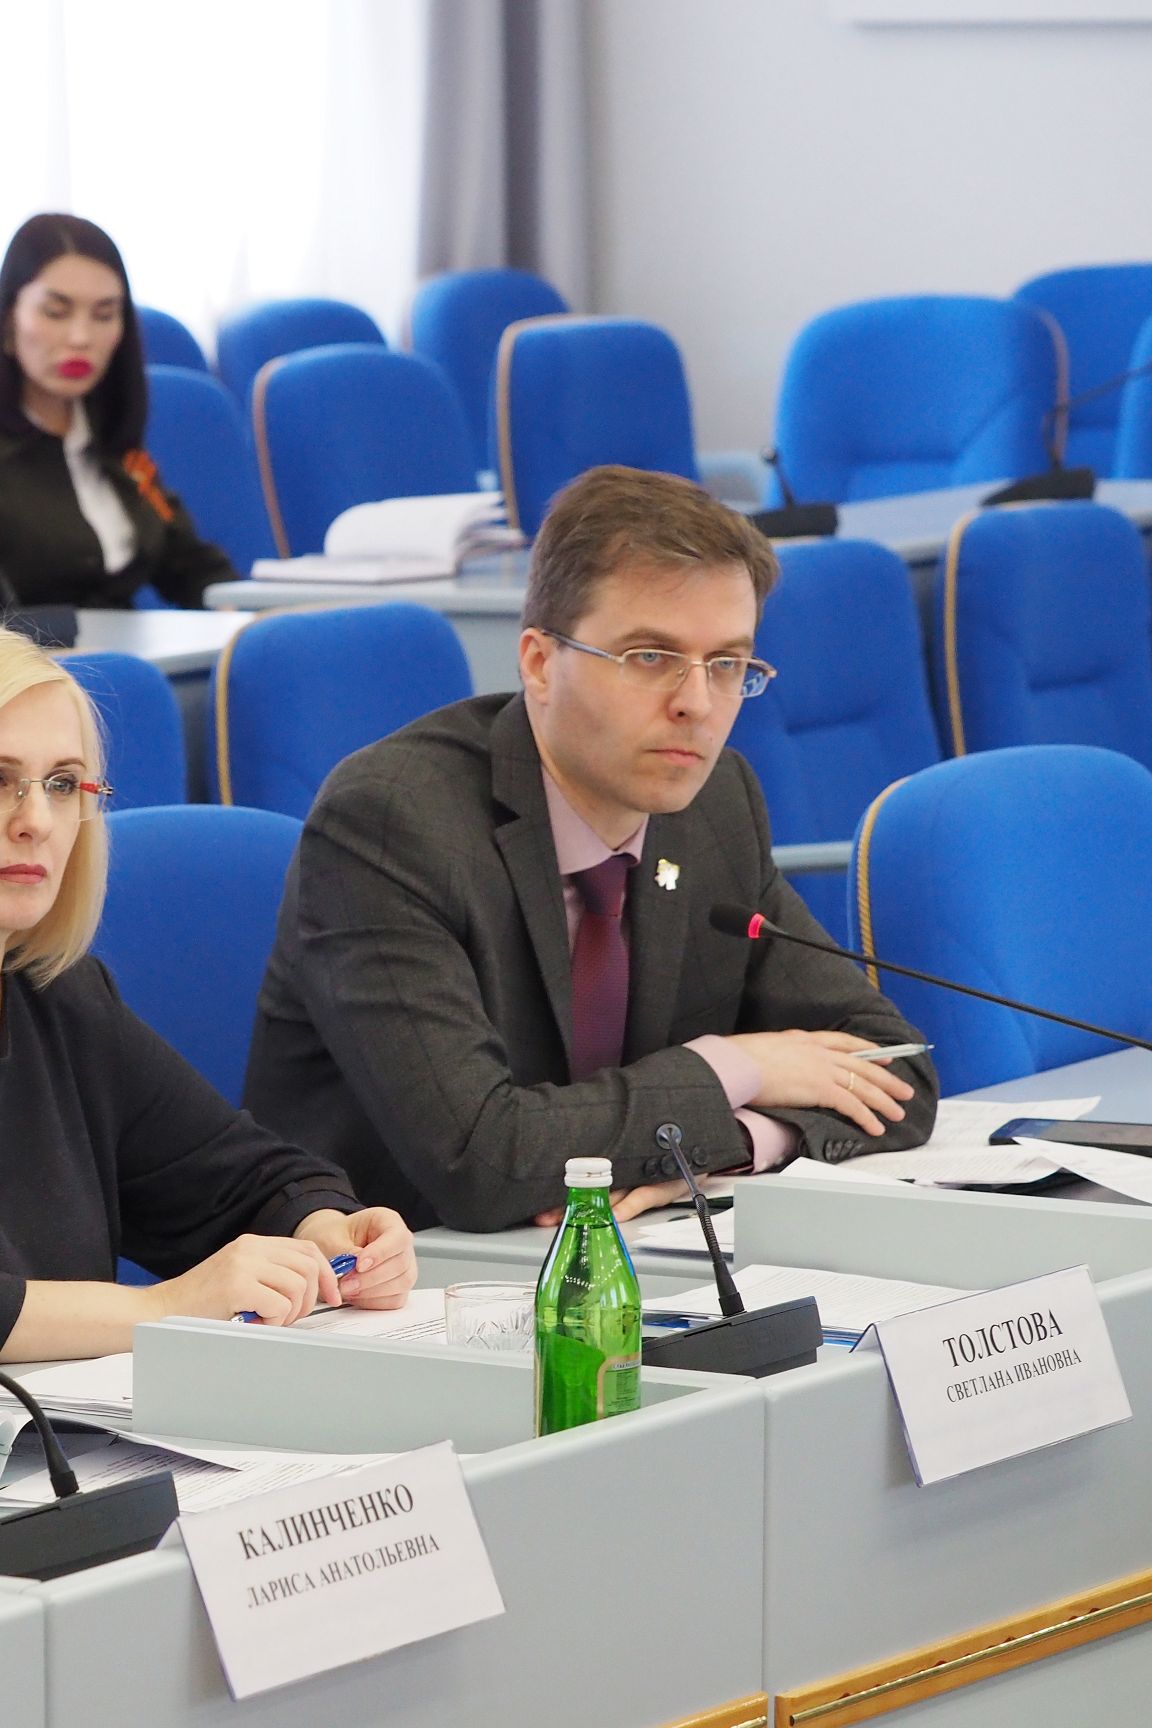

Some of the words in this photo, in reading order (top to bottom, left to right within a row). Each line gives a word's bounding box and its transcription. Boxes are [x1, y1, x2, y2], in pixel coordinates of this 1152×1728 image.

[942, 1309, 1063, 1368] ТОЛСТОВА
[946, 1369, 1014, 1403] СВЕТЛАНА
[1014, 1348, 1083, 1382] ИВАНОВНА
[237, 1483, 415, 1560] КАЛИНЧЕНКО
[246, 1572, 316, 1609] ЛАРИСА
[319, 1533, 441, 1587] АНАТОЛЬЕВНА
